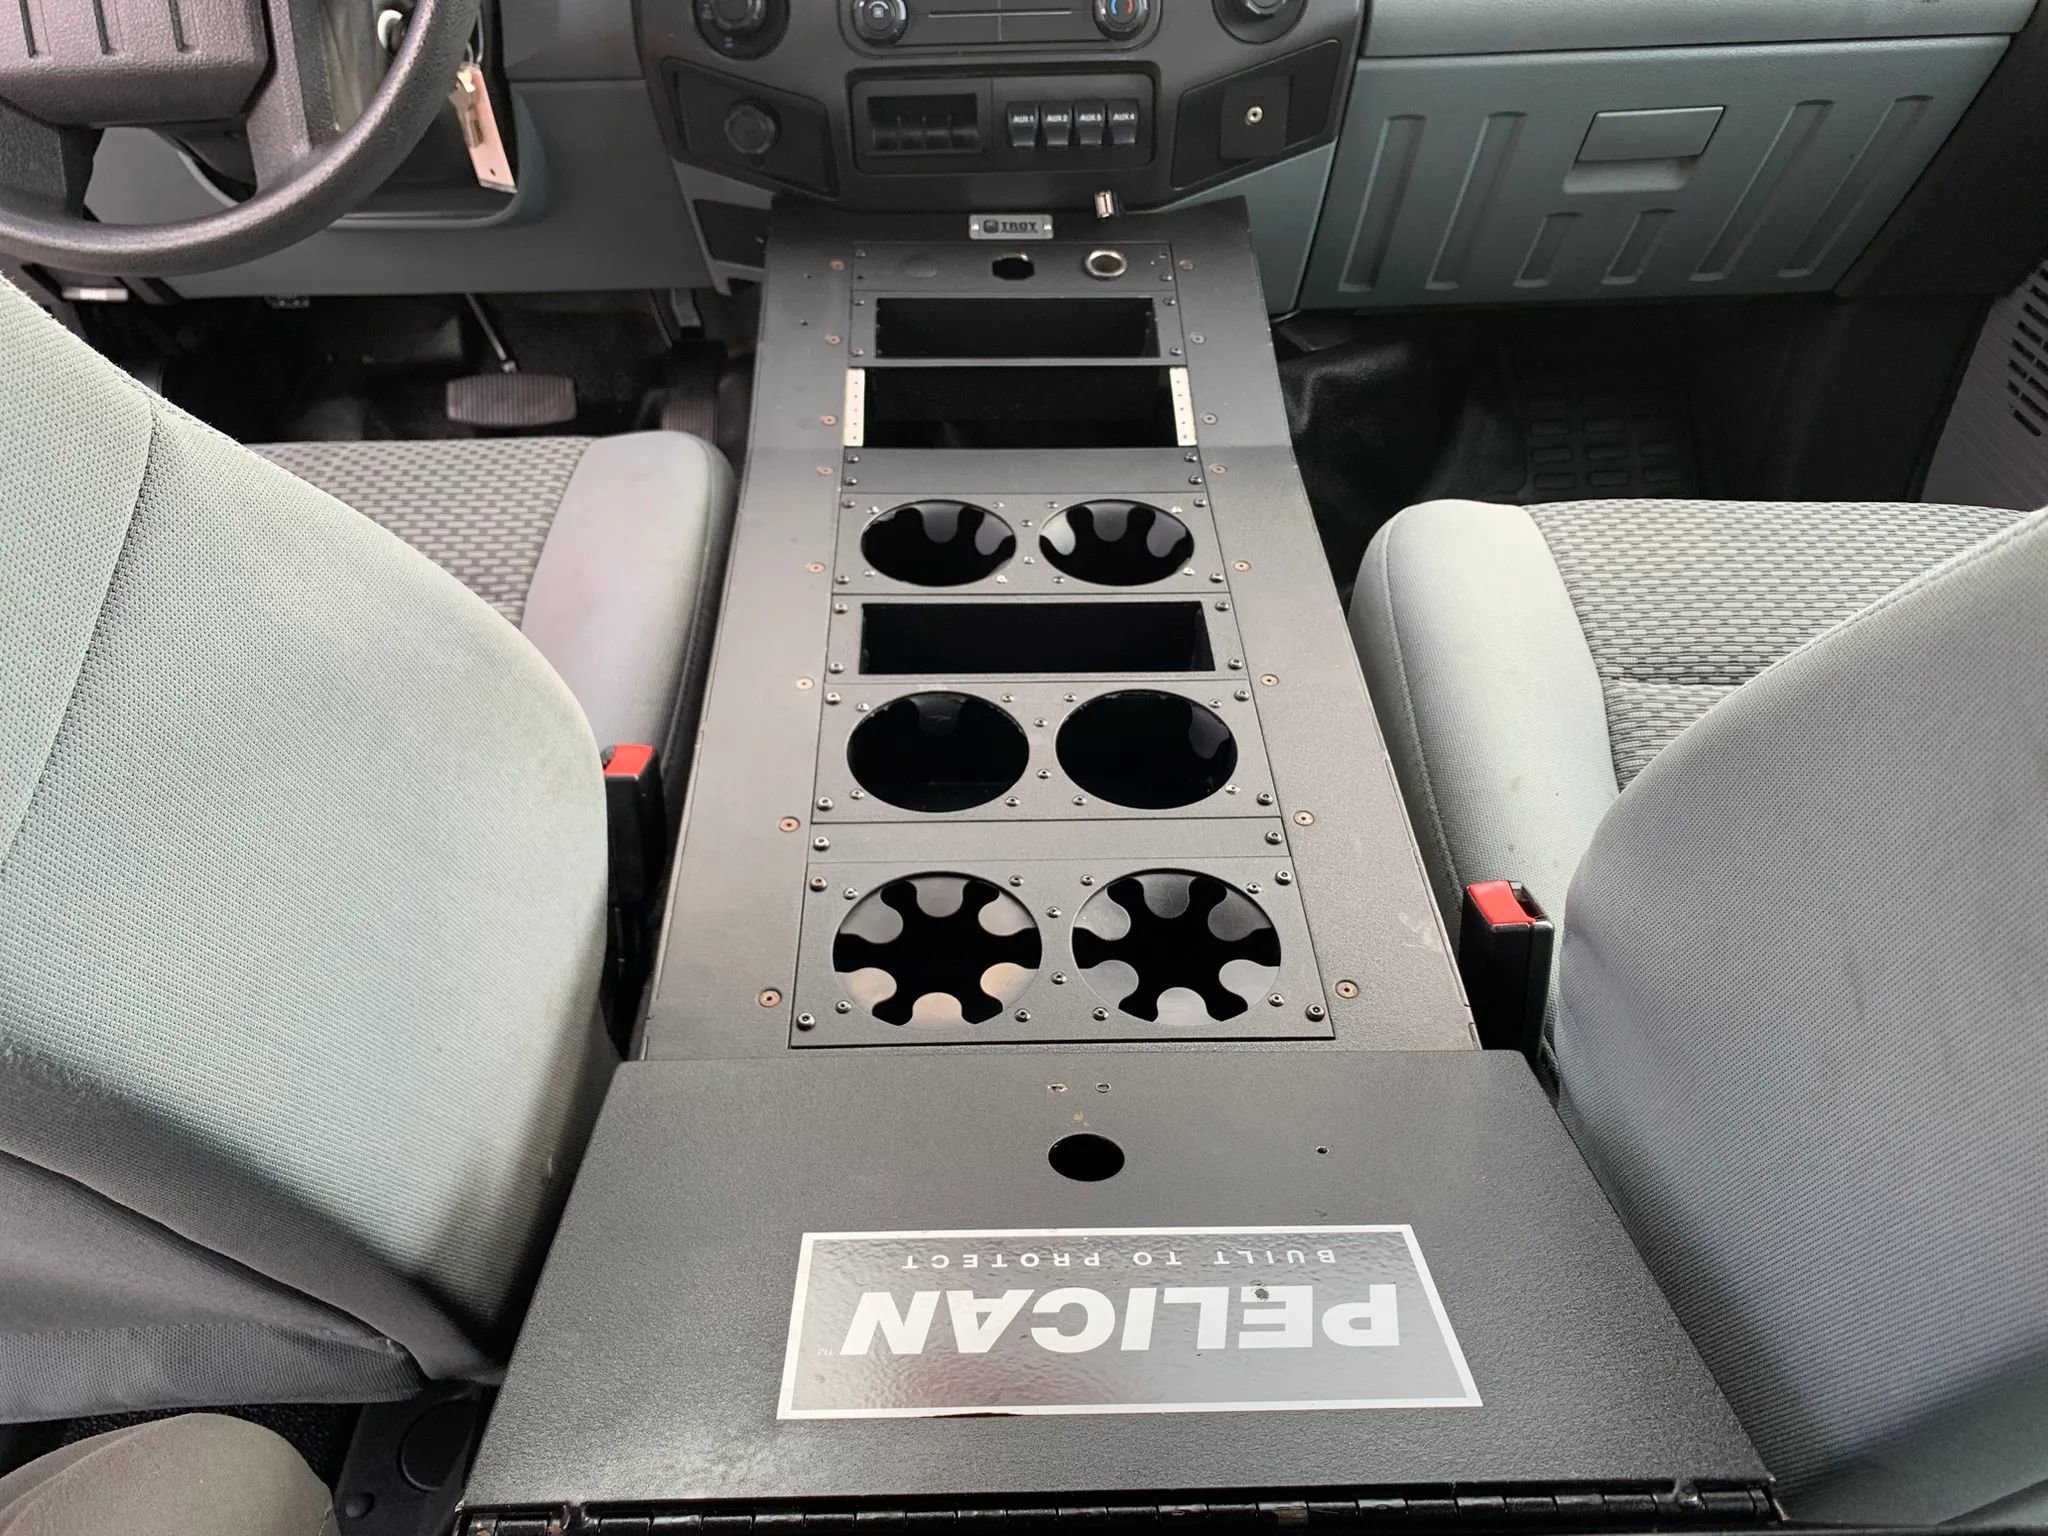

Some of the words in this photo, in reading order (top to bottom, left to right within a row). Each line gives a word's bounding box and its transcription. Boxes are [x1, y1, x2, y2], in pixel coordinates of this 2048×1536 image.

[1012, 115, 1029, 123] AUX
[1046, 113, 1062, 122] AUX
[1079, 113, 1096, 122] AUX
[1112, 112, 1129, 121] AUX
[1001, 221, 1037, 231] TROY
[901, 1252, 1100, 1269] PROTECT
[1132, 1251, 1183, 1266] TO
[1213, 1249, 1336, 1265] BUILT
[839, 1284, 1400, 1356] PELICAN
